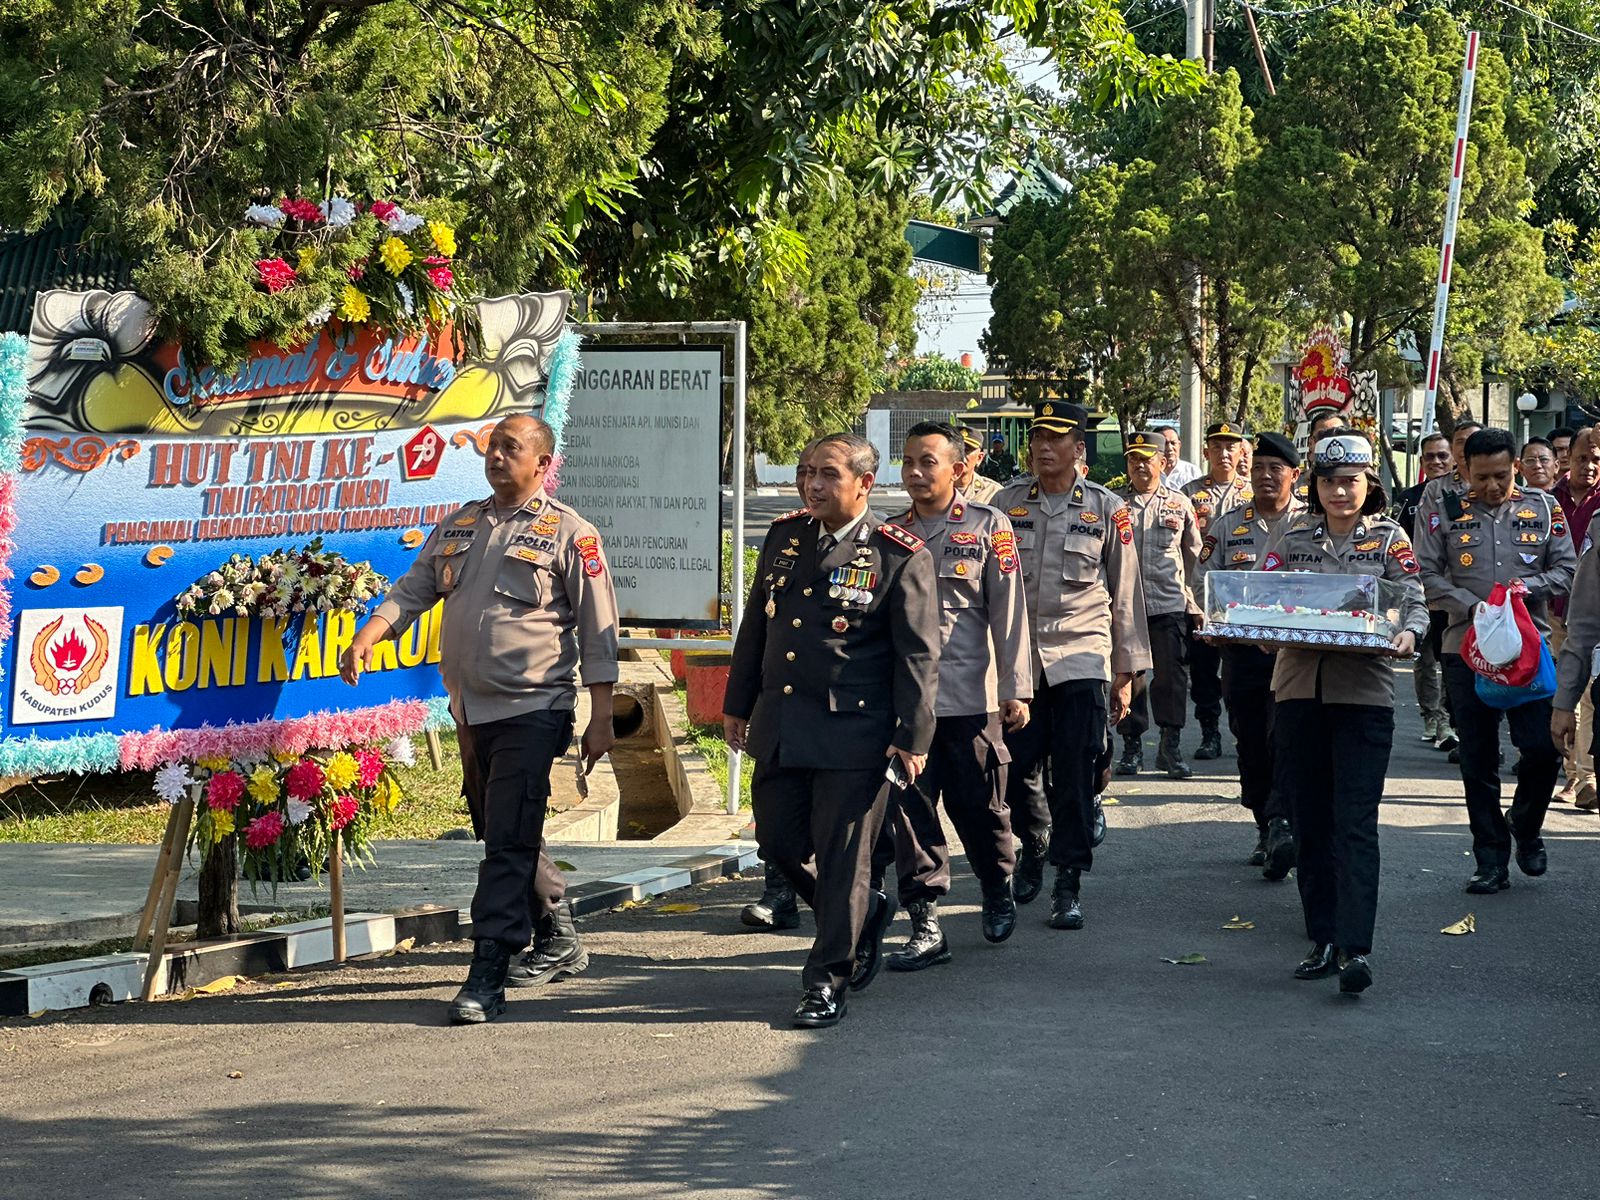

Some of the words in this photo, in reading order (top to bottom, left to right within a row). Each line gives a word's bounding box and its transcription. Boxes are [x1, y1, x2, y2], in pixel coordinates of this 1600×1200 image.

[572, 369, 655, 390] NGGARAN
[659, 369, 712, 390] BERAT
[564, 415, 600, 429] GUNAAN
[602, 415, 637, 429] SENJATA
[654, 415, 682, 430] MUNISI
[683, 416, 700, 429] DAN
[563, 435, 591, 448] LEDAK
[151, 442, 239, 486] HUT
[248, 439, 316, 483] TNI
[412, 431, 438, 471] 78
[562, 455, 600, 468] GUNAAN
[601, 455, 640, 468] NARKOBA
[561, 474, 577, 488] DAN
[579, 474, 640, 488] INSUBORDINASI
[205, 486, 244, 515] TNI
[249, 482, 335, 513] PATRIOT
[340, 479, 390, 508] NKRI
[582, 495, 614, 508] DENGAN
[649, 496, 662, 509] TNI
[663, 496, 681, 509] DAN
[682, 496, 707, 511] POLRI
[105, 519, 193, 545] PENGAWAL
[197, 514, 289, 541] DEMOKRASI
[291, 511, 342, 534] UNTUK
[344, 506, 420, 531] INDONESIA
[587, 515, 614, 528] USILA
[1512, 520, 1543, 531] POLRI
[1069, 524, 1104, 537] POLRI
[443, 530, 475, 539] CATUR
[516, 534, 555, 551] POLRI
[623, 536, 641, 549] DAN
[642, 536, 688, 550] PENCURIAN
[944, 545, 984, 560] POLRI
[1289, 553, 1323, 564] INTAN
[1348, 552, 1386, 563] POLRI
[611, 556, 644, 569] ILLEGAL
[680, 558, 713, 572] ILLEGAL
[129, 617, 250, 696] KONI
[20, 688, 77, 716] KABUPATEN
[80, 684, 113, 713] KUDUS
